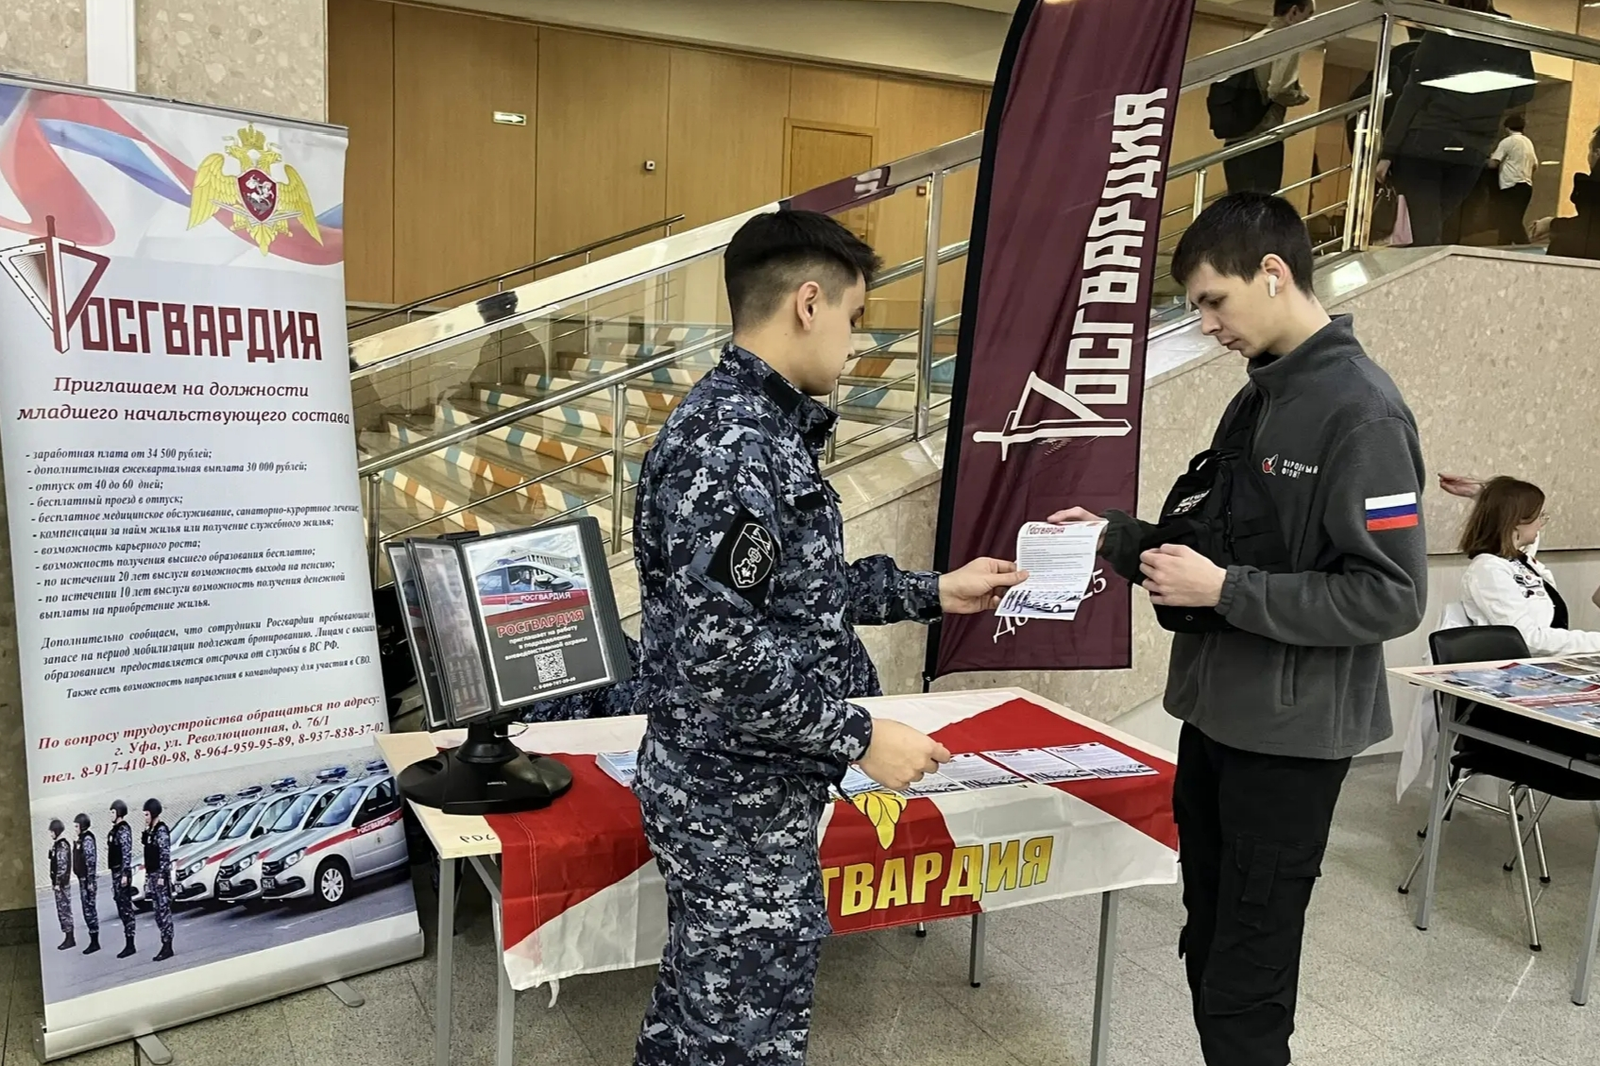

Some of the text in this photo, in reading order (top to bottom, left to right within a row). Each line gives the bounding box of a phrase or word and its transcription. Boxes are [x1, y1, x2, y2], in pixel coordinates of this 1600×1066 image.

[53, 377, 309, 399] Приглашаем на должности
[17, 406, 349, 425] младшего начальствующего состава
[33, 448, 212, 461] заработная плата от 34 500 рублей;
[34, 461, 308, 476] дополнительная ежеквартальная выплата 30 000 рублей;
[35, 479, 164, 493] отпуск от 40 до 60 дней;
[37, 495, 102, 507] бесплатный
[105, 494, 136, 508] проезд
[145, 496, 183, 506] отпуск;
[38, 512, 100, 523] бесплатное
[102, 510, 164, 521] медицинское
[166, 508, 234, 521] обслуживание,
[236, 504, 331, 517] санаторно-курортное
[40, 518, 334, 540] компенсации за найм жилья или получение служебного жилья;
[41, 540, 201, 555] возможность карьерного роста;
[42, 548, 316, 571] возможность получения высшего образования бесплатно;
[44, 559, 335, 587] по истечении 20 лет выслуги возможность выхода на пенсию;
[45, 573, 346, 603] по истечении 10 лет выслуги возможность получения денежной
[520, 591, 572, 601] РОСГВАРДИЯ
[39, 600, 211, 620] выплаты на приобретение жилья.
[41, 634, 124, 650] Дополнительно
[129, 628, 179, 641] сообщаем,
[184, 626, 203, 635] что
[207, 621, 262, 635] сотрудники
[266, 616, 314, 628] Росгвардии
[496, 609, 585, 638] РОСГВАРДИЯ
[43, 654, 78, 665] запасе
[80, 652, 94, 661] на
[96, 646, 130, 661] период
[132, 641, 195, 656] мобилизации
[197, 636, 246, 649] подлежат
[247, 631, 313, 647] бронированию.
[314, 627, 344, 637] Лицам
[44, 639, 340, 683] образованием предоставляется отсрочка от службы в ВС РФ.
[66, 687, 99, 699] Также
[99, 685, 121, 695] есть
[122, 679, 183, 692] возможность
[184, 671, 237, 686] направления
[244, 665, 299, 678] командировку
[300, 662, 314, 672] для
[315, 660, 348, 672] участия
[38, 696, 380, 750] По вопросу трудоустройства обращаться по адресу:
[114, 715, 330, 756] г. Уфа, ул. Революционная, д. 76/1
[42, 722, 384, 784] тел. 8-917-410-80-98, 8-964-959-95-89, 8-937-838-37-02
[821, 835, 1055, 917] ГВАРДИЯ
